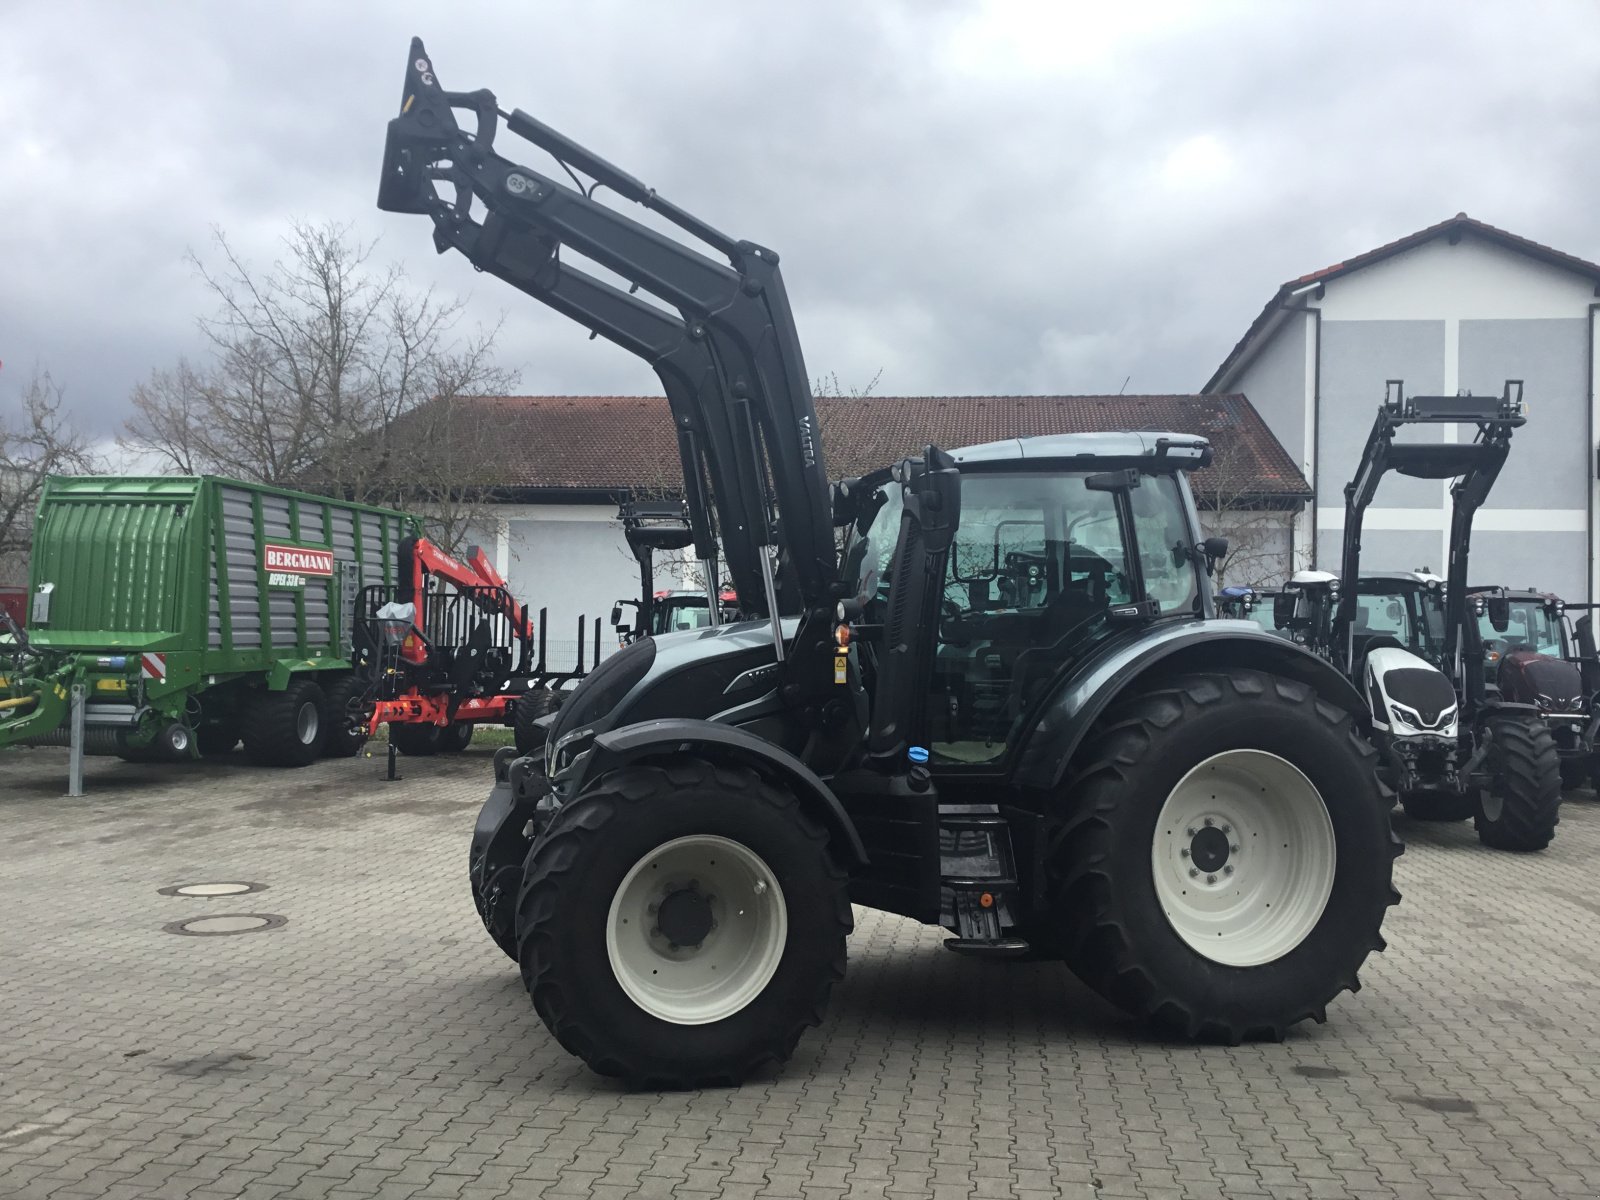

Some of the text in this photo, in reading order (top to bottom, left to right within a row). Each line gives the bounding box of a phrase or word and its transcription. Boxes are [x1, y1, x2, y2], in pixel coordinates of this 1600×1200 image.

[798, 415, 815, 468] VALTRA
[267, 550, 331, 570] BERGMANN
[268, 573, 287, 585] REPEX
